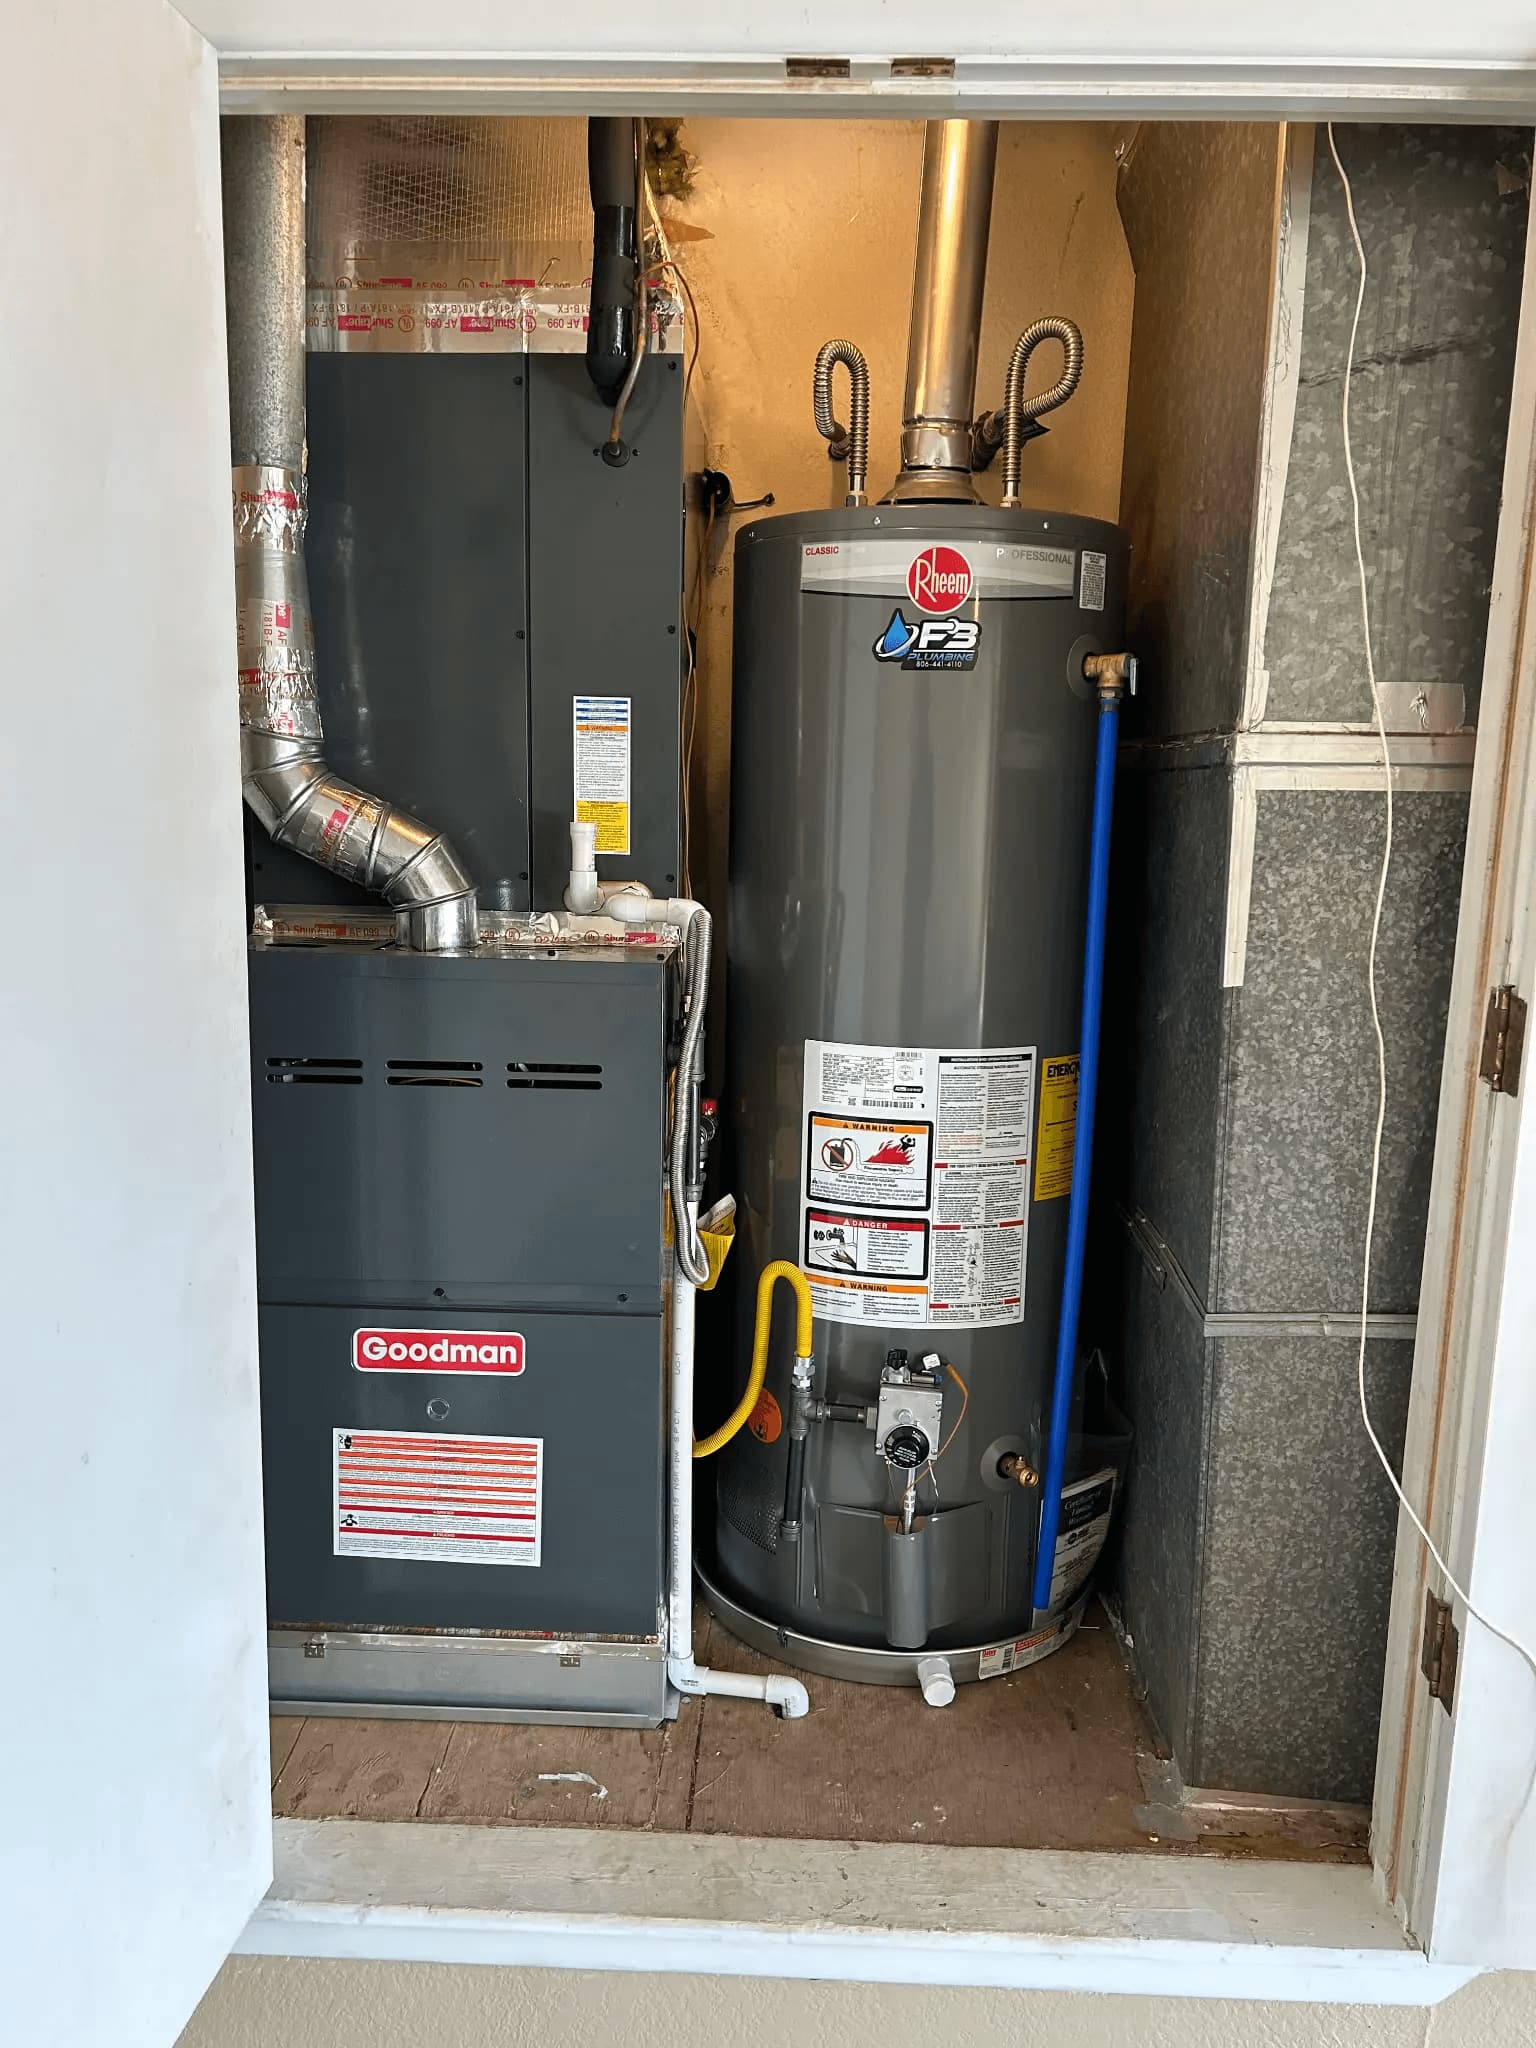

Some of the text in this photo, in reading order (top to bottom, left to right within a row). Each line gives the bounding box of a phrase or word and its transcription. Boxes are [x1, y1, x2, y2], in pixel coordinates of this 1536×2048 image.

[321, 318, 335, 328] AF
[425, 319, 442, 329] 099
[444, 319, 458, 329] AF
[547, 319, 580, 329] AF 099
[805, 546, 839, 556] CLASSIC
[996, 547, 1073, 565] POFESSIONAL
[914, 548, 969, 603] Rheem
[907, 652, 975, 662] PLUMBING
[915, 660, 963, 668] 806-441-4110
[852, 1123, 895, 1132] WARNING
[852, 1220, 888, 1229] DANGER
[850, 1282, 888, 1292] WARNING
[362, 1336, 517, 1365] Goodman
